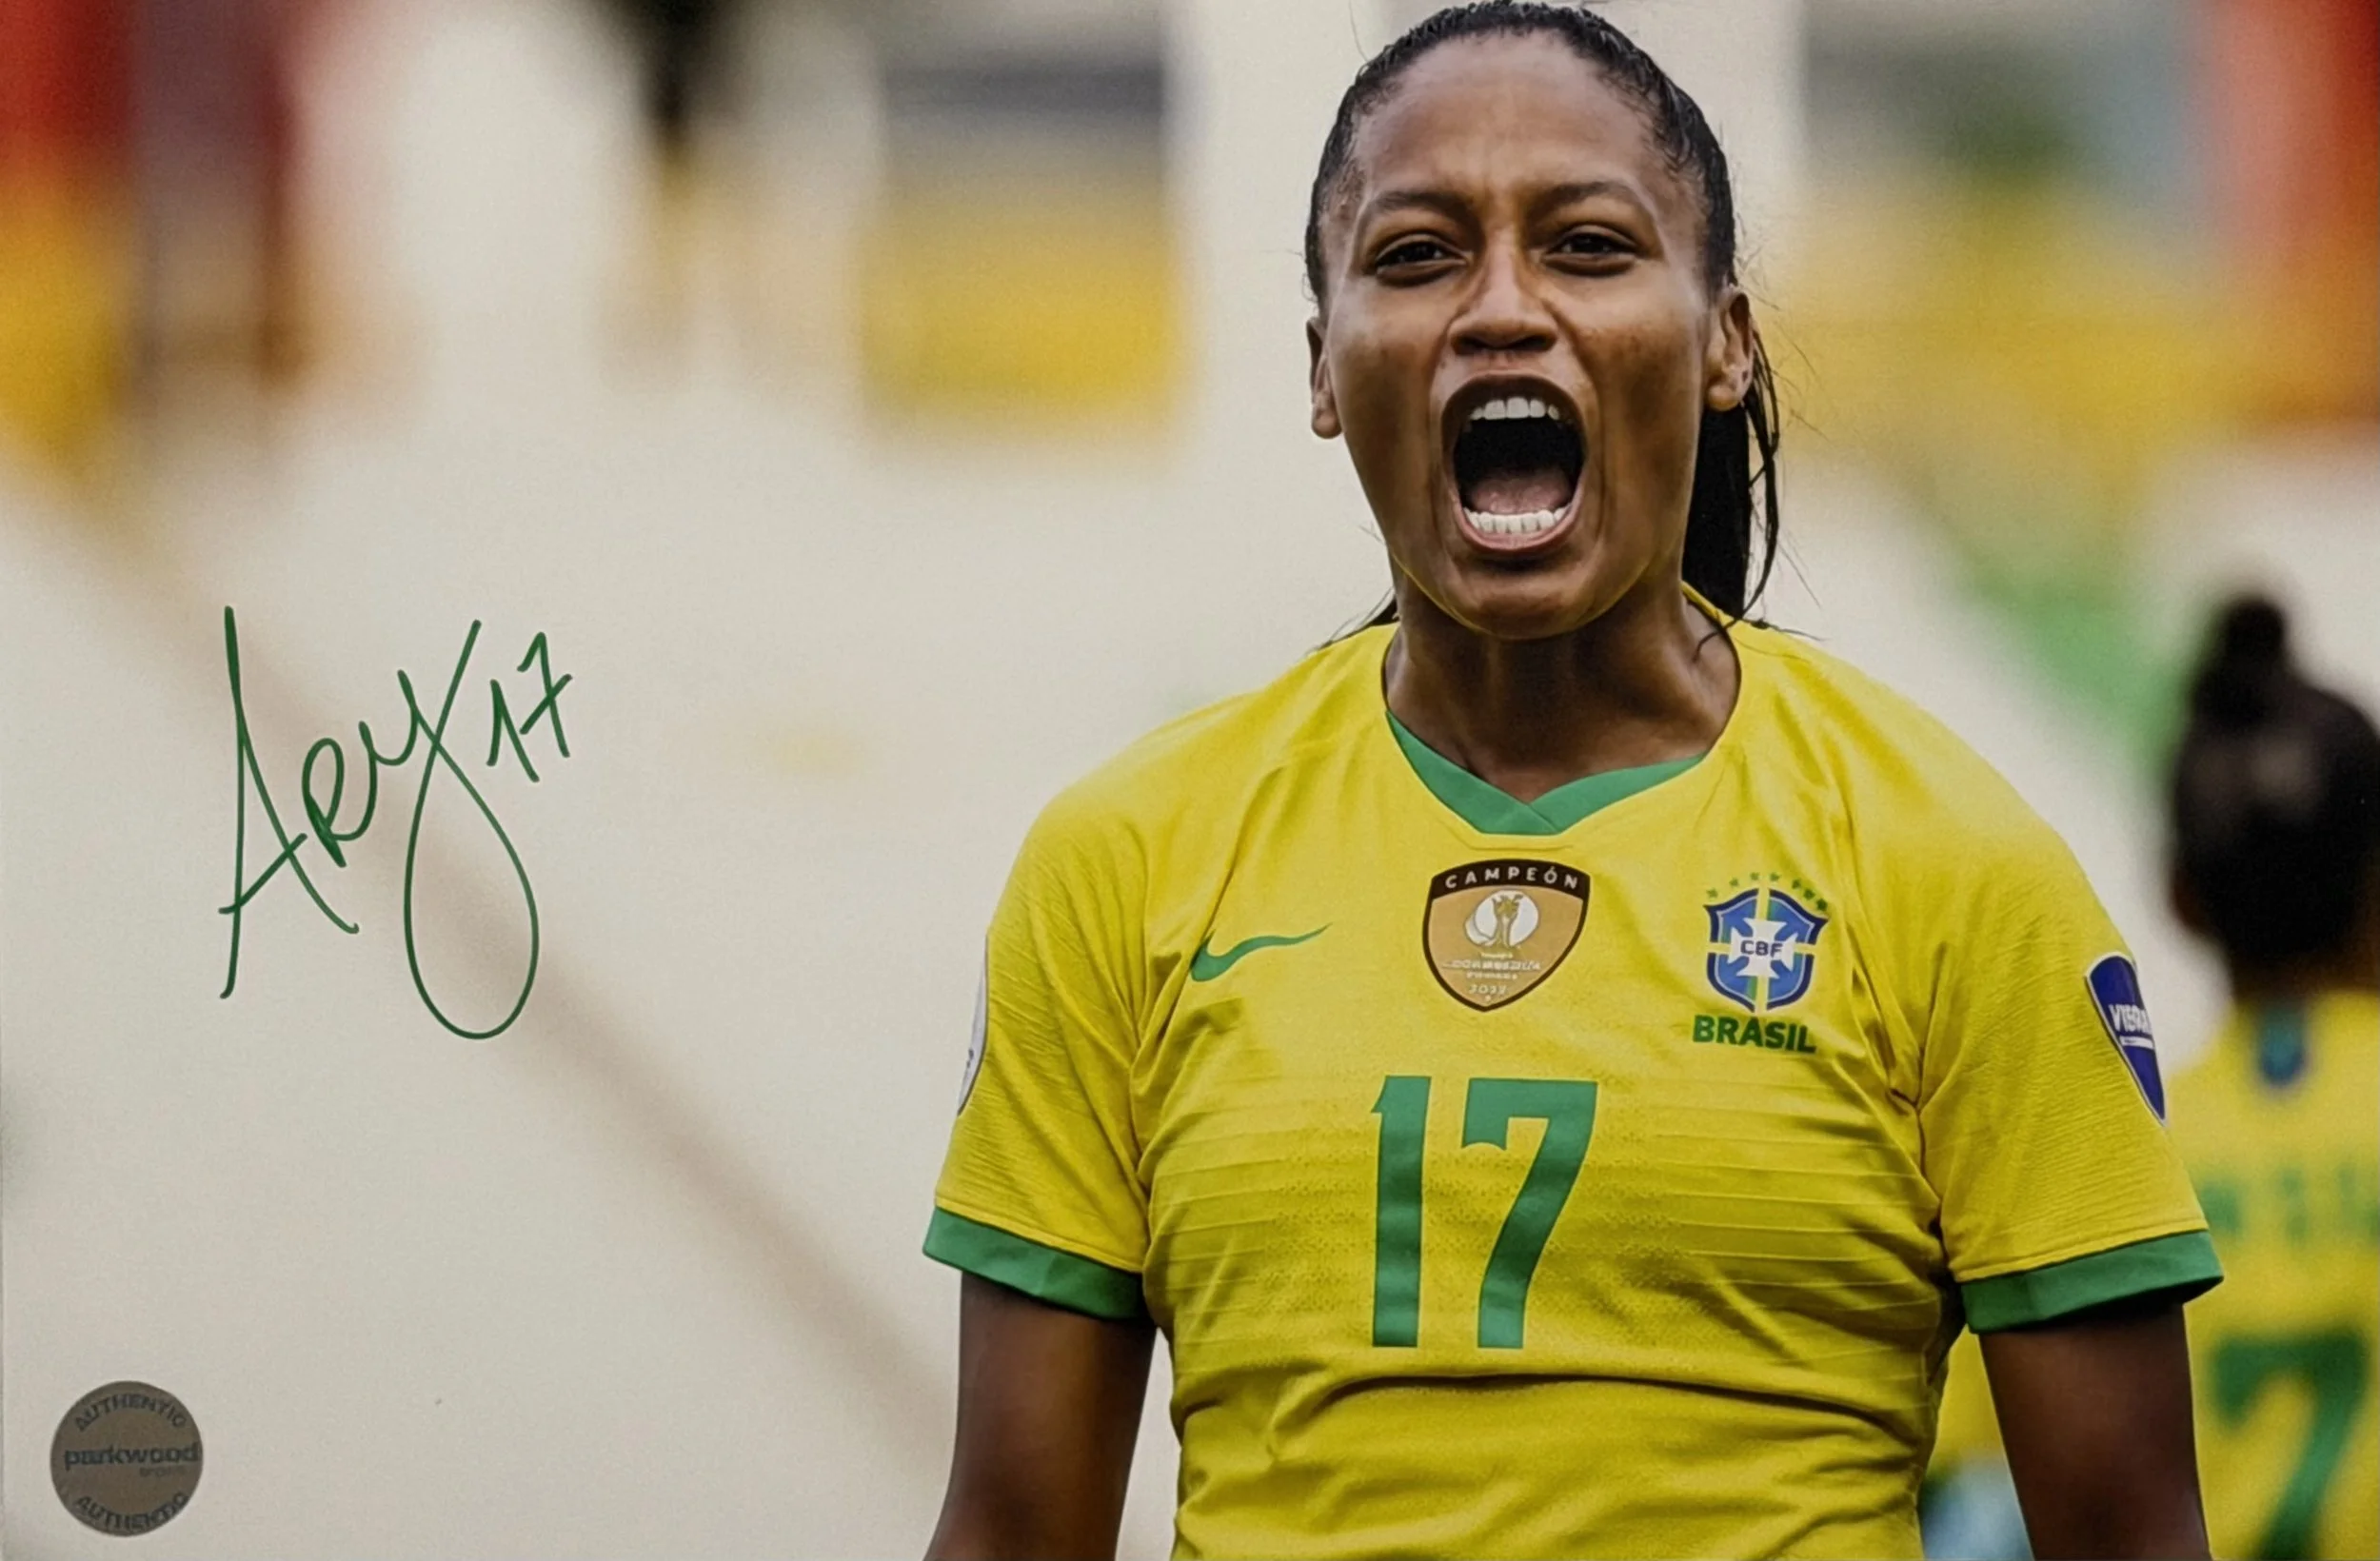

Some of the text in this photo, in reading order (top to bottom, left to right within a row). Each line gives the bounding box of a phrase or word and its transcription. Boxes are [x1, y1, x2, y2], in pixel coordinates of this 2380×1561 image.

[486, 631, 573, 783] 17
[1445, 866, 1577, 890] CAMPEÓN
[1740, 939, 1783, 958] CBF
[1692, 1014, 1817, 1054] BRASIL
[1371, 1075, 1598, 1349] 17
[64, 1441, 199, 1472] parkwood
